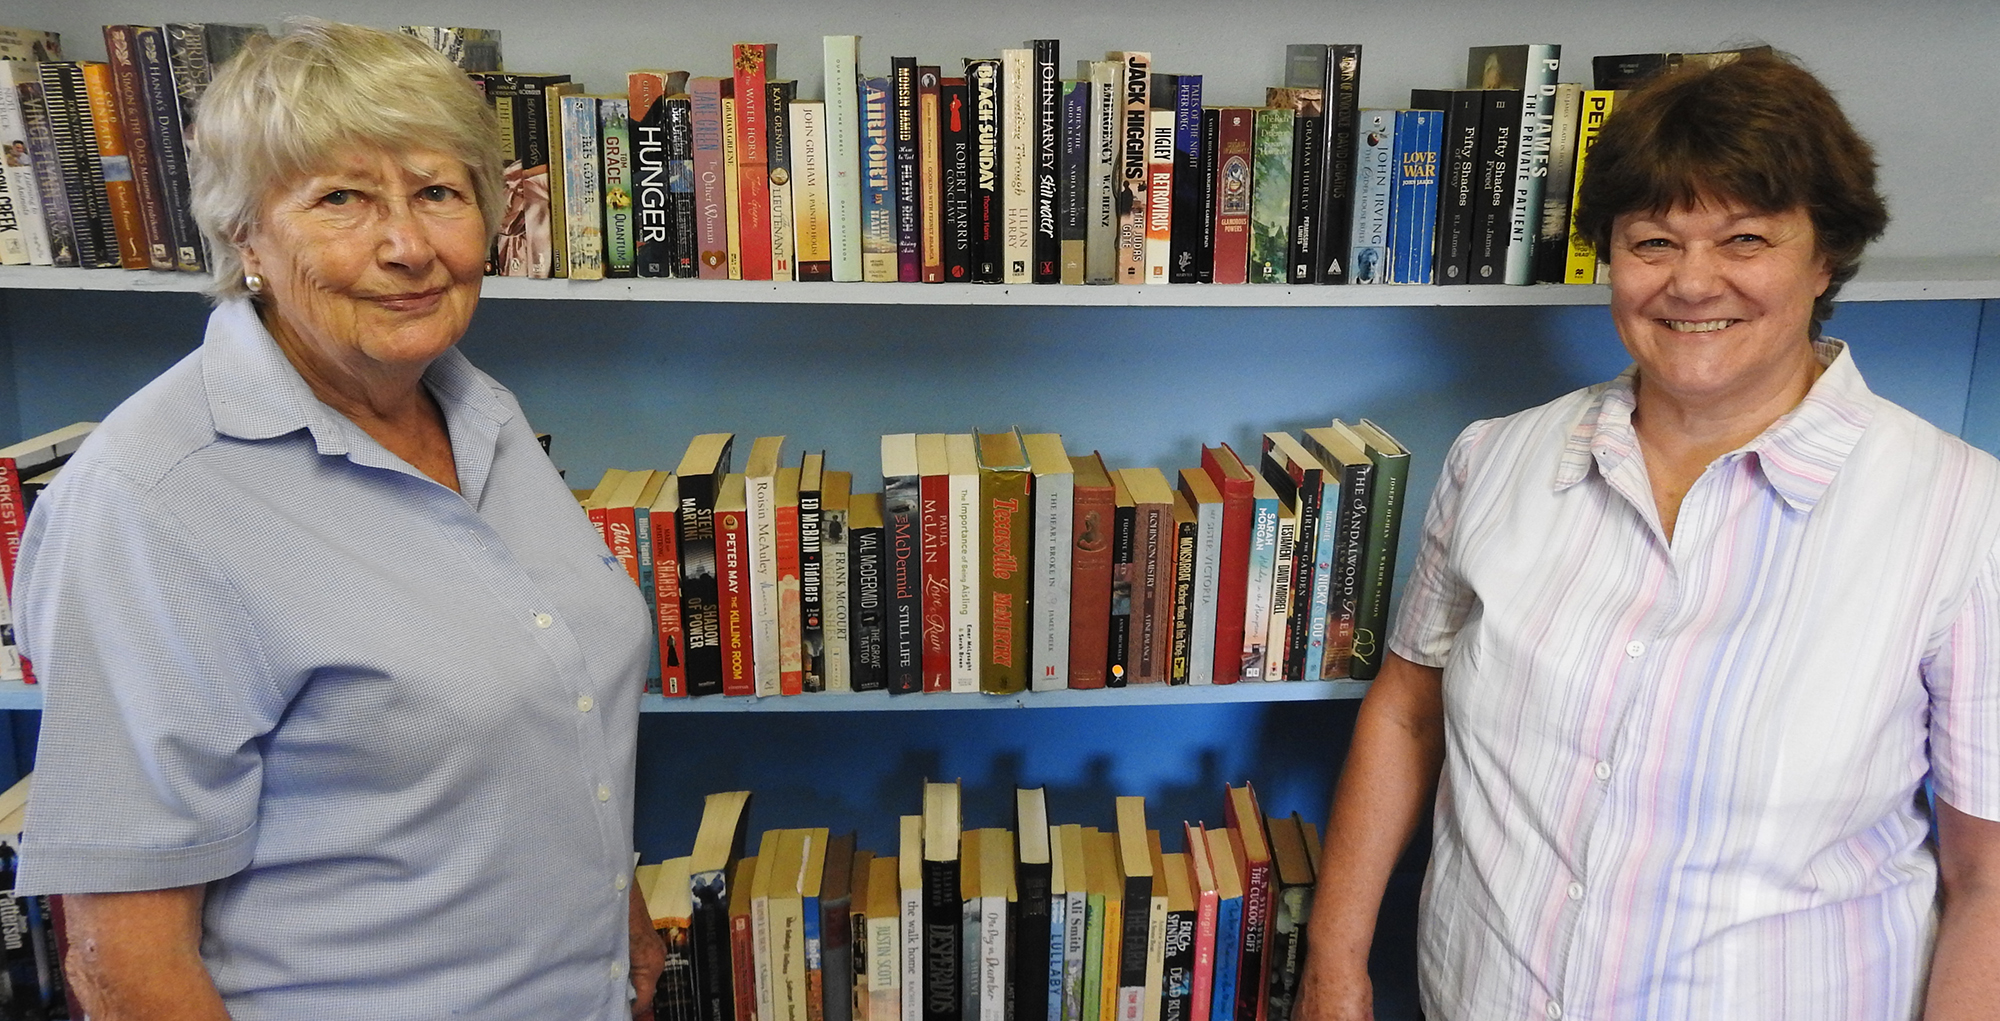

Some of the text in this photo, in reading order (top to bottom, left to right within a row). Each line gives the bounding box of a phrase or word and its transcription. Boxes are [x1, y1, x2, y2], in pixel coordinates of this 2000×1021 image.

[695, 91, 718, 150] JANE GREEN
[746, 88, 754, 122] WATER
[773, 88, 784, 162] KATE GRENVILLE
[898, 68, 911, 141] MOHSIN HAMID
[977, 66, 994, 191] BLACK SUNDAY
[1040, 62, 1054, 169] JOHN HARVEY
[1102, 83, 1114, 166] EMERGENCY
[1125, 57, 1146, 179] JACK HIGGINS
[1191, 110, 1199, 120] OF
[1532, 58, 1558, 178] P. D. JAMES
[24, 98, 60, 198] VINCE FLYNN
[802, 109, 815, 186] JOHN GRISHAM
[867, 86, 888, 204] AIRPORT BY
[1154, 128, 1171, 160] HIGLEY
[1190, 124, 1198, 138] THE
[1190, 142, 1198, 168] NIGHT
[582, 136, 593, 204] IRIS GOWER
[606, 136, 620, 184] GRACE
[1302, 120, 1312, 211] GRAHAM HURLEY
[1403, 151, 1437, 164] LOVE
[1403, 164, 1436, 177] WAR
[1451, 148, 1460, 188] of Grey
[1459, 127, 1474, 206] Fifty Shades
[1484, 160, 1494, 189] Freed
[1492, 127, 1508, 206] Fifty Shades
[1513, 95, 1536, 242] THE PRIVATE PATIENT
[638, 127, 665, 242] HUNGER
[946, 169, 955, 224] CONCLAVE
[956, 143, 967, 249] ROBERT HARRIS
[1151, 173, 1170, 231] RETROVIRUS
[1371, 148, 1388, 245] JOHN IRVING
[614, 214, 626, 260] QUANTUM
[772, 189, 783, 257] LIEUTENANT
[809, 199, 817, 230] PAINTED
[1008, 208, 1017, 248] HARRY
[1019, 208, 1028, 248] LILIAN
[1122, 224, 1132, 248] GATE
[1132, 212, 1143, 261] THE JUDAS
[1484, 228, 1493, 257] James
[682, 498, 697, 541] MARTINI
[697, 509, 712, 540] STEVE
[756, 482, 770, 574] Roisin McAuley
[802, 498, 815, 510] ED
[960, 503, 969, 554] Importance
[1256, 508, 1266, 550] MORGAN
[1323, 511, 1332, 542] NATANIEL
[1384, 477, 1396, 538] JOSEPH OLSHAN
[726, 533, 736, 568] PETER
[803, 514, 817, 553] McBAIN
[924, 500, 937, 563] McLAIN
[939, 516, 947, 546] PAULA
[1146, 513, 1157, 588] ROHINTON MISTRY
[1265, 513, 1276, 546] SARAH
[1339, 469, 1367, 637] THE SANDALWOOD TREE
[728, 571, 738, 593] MAY
[804, 563, 818, 602] Fiddlers
[860, 533, 877, 608] VAL McDERMID
[960, 564, 968, 582] Being
[993, 498, 1018, 667] Texasville McMURTRY
[1049, 546, 1057, 575] BROKE
[1049, 578, 1055, 587] IN
[1202, 555, 1213, 605] VICTORIA
[1274, 524, 1293, 614] TESTAMENT DAVID MORRELL
[658, 560, 679, 632] SHARDS ASHES
[836, 552, 846, 641] FRANK McCOURT
[895, 523, 912, 667] McDermid STILL LIFE
[960, 585, 969, 615] Aisling
[1312, 574, 1328, 637] NICKY LOU
[688, 598, 703, 649] OF POWER
[704, 604, 718, 646] SHADOW
[730, 610, 740, 648] KILLING
[733, 651, 741, 679] ROOM
[861, 636, 870, 663] TATTOO
[872, 644, 880, 668] GRAVE
[1, 890, 22, 949] Patterson
[1070, 898, 1082, 953] Ali Smith
[1245, 867, 1261, 952] THE CUCKOO'S GIFT
[809, 939, 820, 969] holes
[877, 926, 891, 986] JUSTIN SCOTT
[908, 901, 918, 974] the walk home
[1166, 914, 1178, 958] SPINDLER
[1177, 921, 1192, 952] ERICA
[1286, 927, 1298, 974] STEWART
[929, 924, 954, 1012] DESPERADOS
[1049, 934, 1063, 994] LULLABY
[1169, 967, 1182, 997] DEAD
